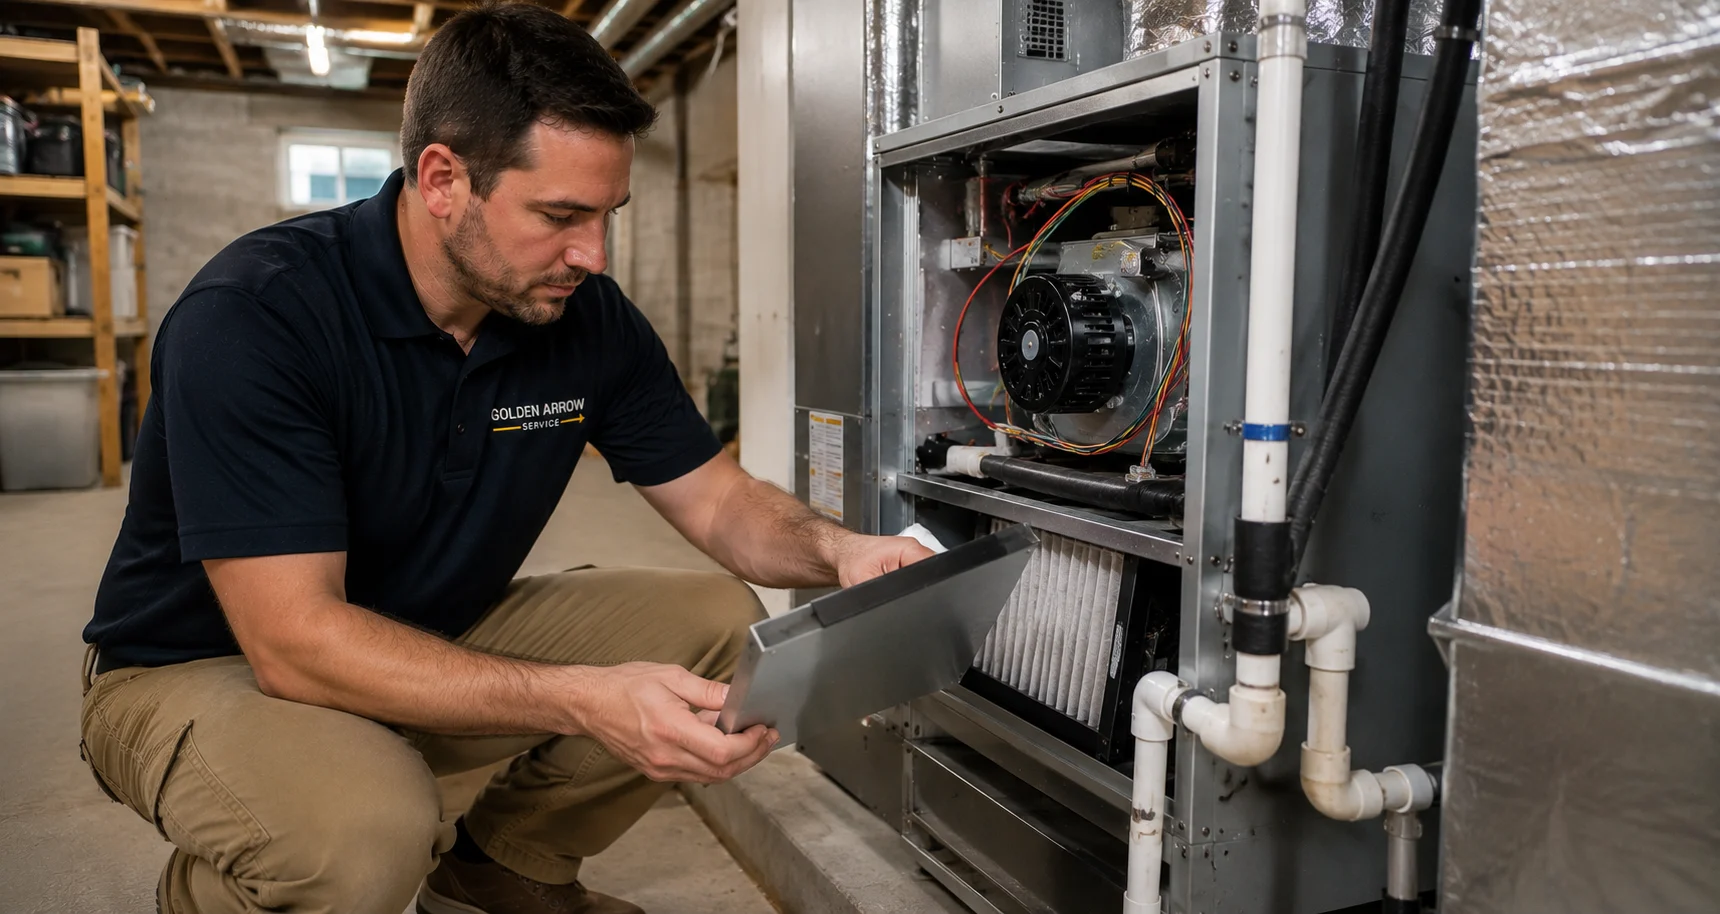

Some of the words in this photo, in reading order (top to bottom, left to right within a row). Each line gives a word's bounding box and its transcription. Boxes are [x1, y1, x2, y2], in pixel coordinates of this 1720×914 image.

[491, 405, 540, 421] GOLDEN
[543, 398, 585, 415] ARROW
[522, 418, 560, 431] SERVICE
